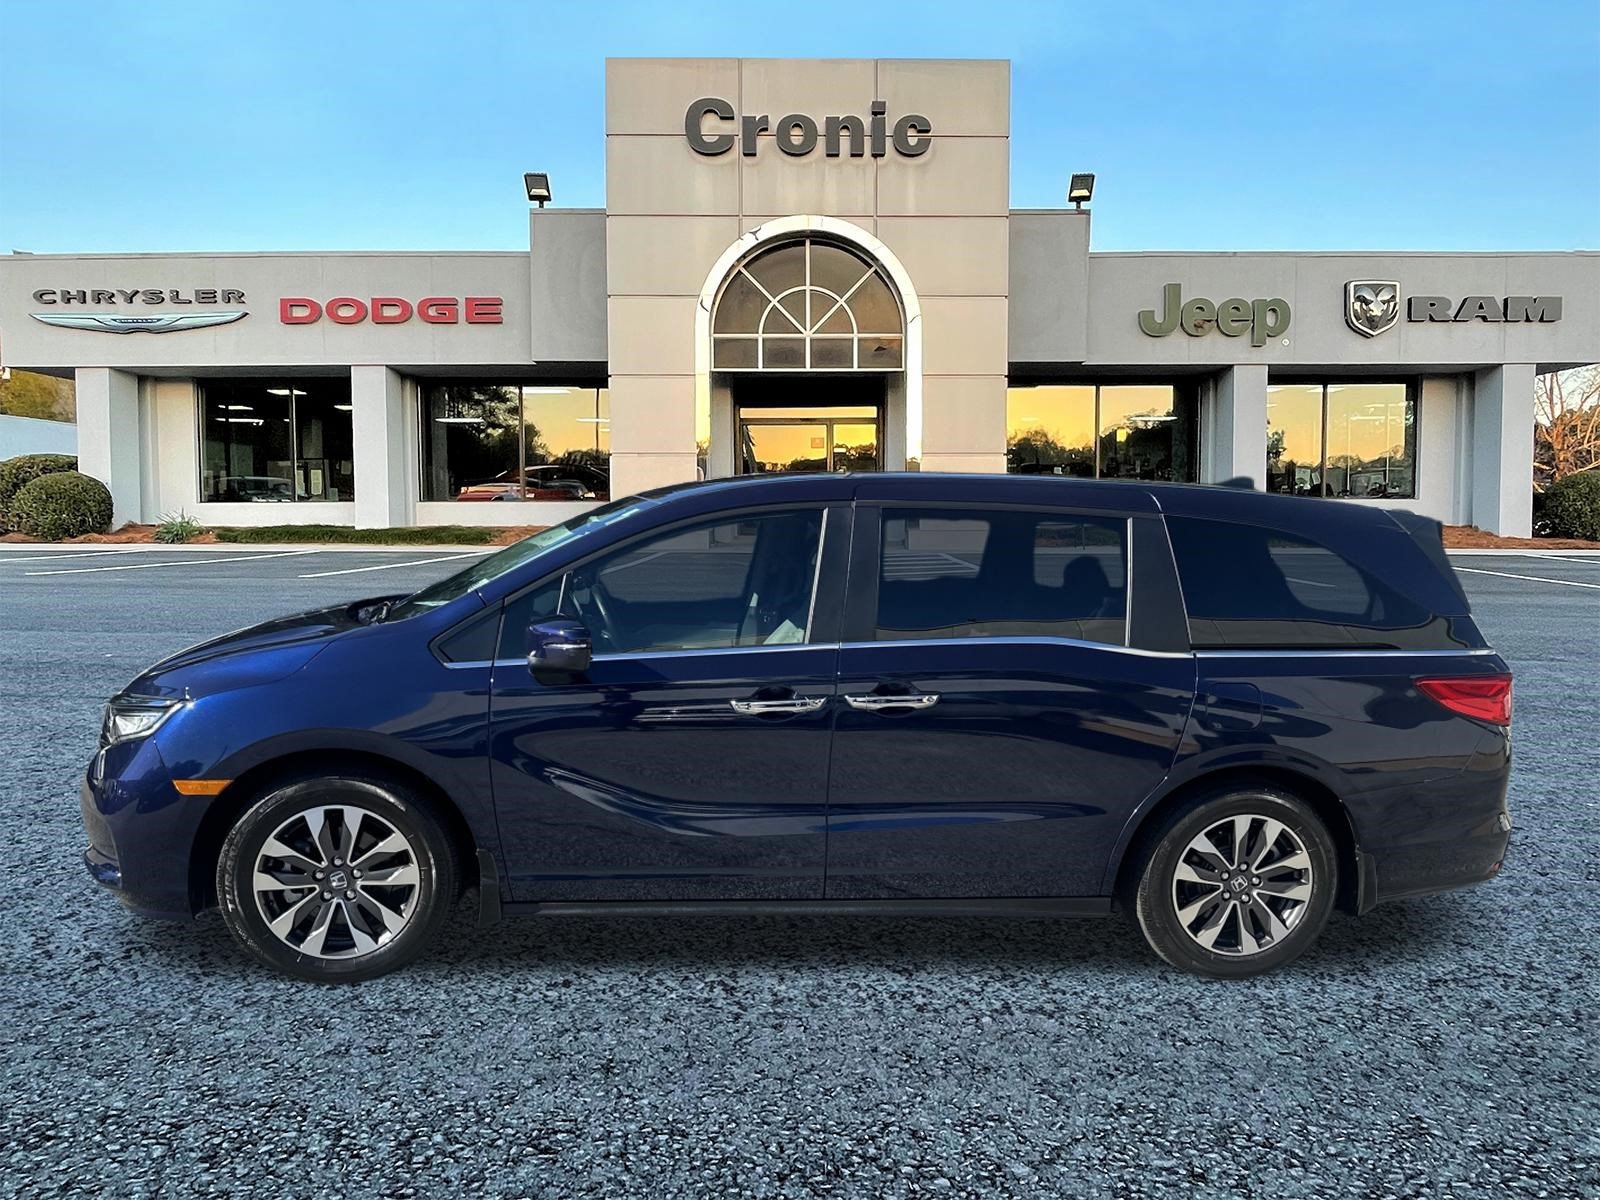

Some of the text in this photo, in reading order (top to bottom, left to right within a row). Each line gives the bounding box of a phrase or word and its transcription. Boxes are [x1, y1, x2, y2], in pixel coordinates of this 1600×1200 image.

[684, 97, 932, 157] Cronic
[32, 288, 247, 305] CHRYSLER
[1407, 296, 1563, 323] RAM
[279, 297, 504, 325] DODGE
[1137, 283, 1291, 347] Jeep
